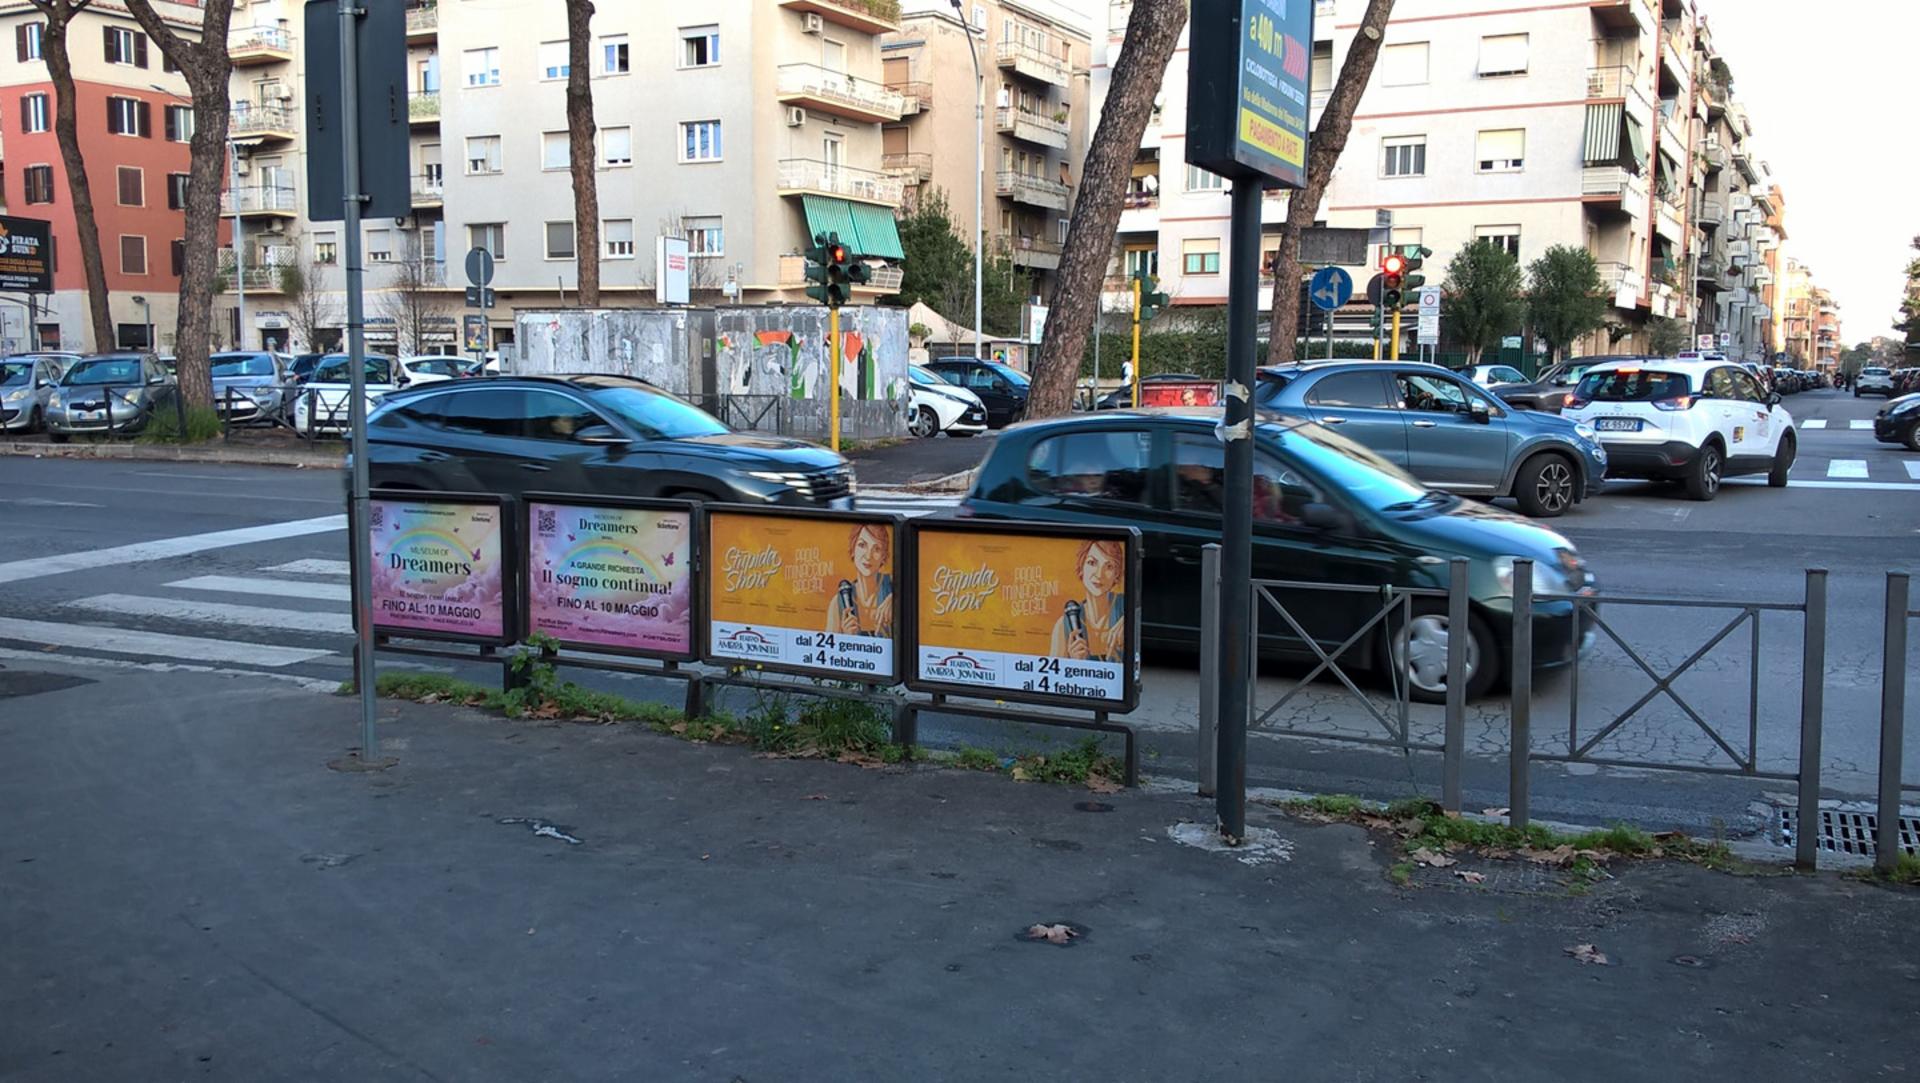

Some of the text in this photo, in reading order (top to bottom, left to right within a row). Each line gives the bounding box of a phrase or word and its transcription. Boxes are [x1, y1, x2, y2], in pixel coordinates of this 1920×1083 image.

[11, 235, 40, 246] PIRATA
[579, 518, 639, 535] Dreamers
[390, 552, 472, 576] Dreamers
[570, 560, 645, 575] A GRANDE RICHIESTA
[721, 543, 784, 573] Stupida
[542, 569, 673, 596] Il sogno continua!
[724, 568, 779, 593] Show
[929, 561, 1000, 595] Stupida
[382, 599, 406, 612] FINO
[408, 602, 422, 613] AL
[424, 604, 435, 615] 10
[438, 605, 481, 620] MAGGIO
[557, 597, 659, 618] FINO AL 10 MAGGIO
[933, 588, 995, 617] Show
[795, 632, 883, 655] dal 24 gennaio
[802, 650, 876, 671] al 4 febbraio
[1015, 657, 1115, 681] dal 24 gennaio
[1023, 676, 1107, 699] al 4 febbraio
